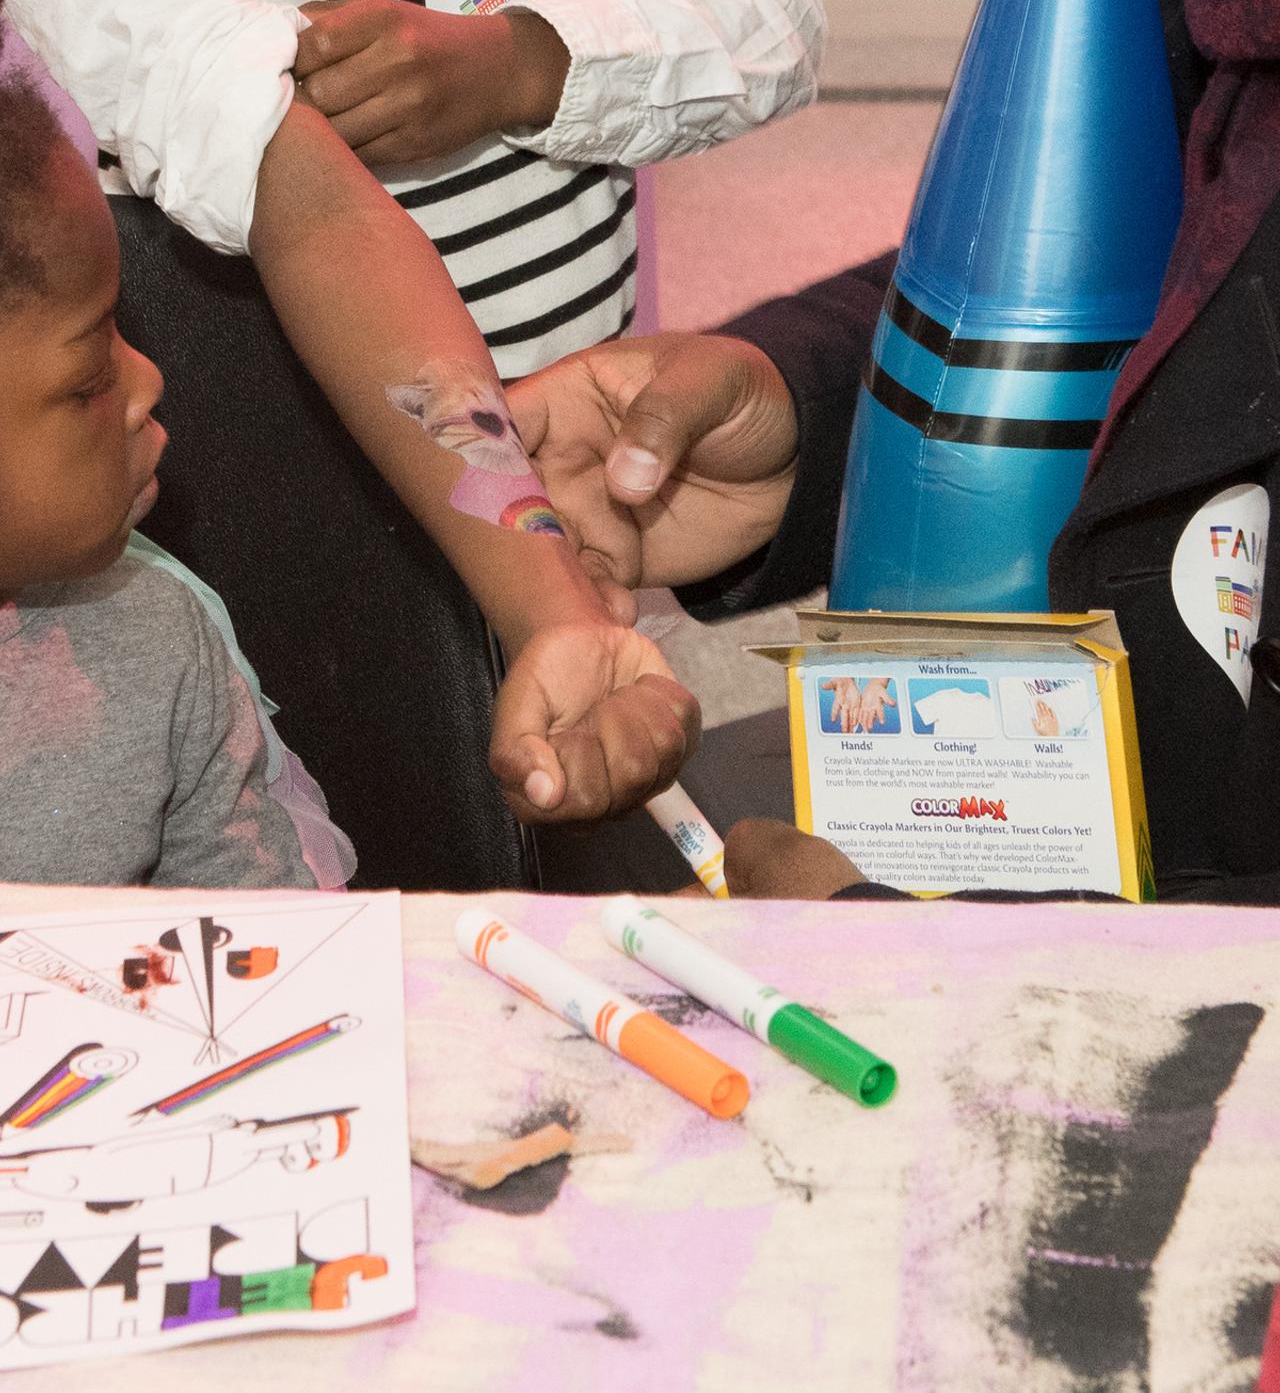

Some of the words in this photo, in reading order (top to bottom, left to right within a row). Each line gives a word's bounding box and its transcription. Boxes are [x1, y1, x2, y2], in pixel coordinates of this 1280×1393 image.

[918, 664, 945, 675] Wash
[946, 664, 977, 675] from...
[841, 740, 873, 751] Hands!
[934, 742, 977, 756] Clothing!
[1034, 743, 1064, 754] Walls!
[824, 756, 852, 768] Crayola
[854, 757, 889, 766] Washable
[891, 758, 922, 766] Markers
[956, 759, 983, 768] ULTRA
[1035, 760, 1073, 769] Washable
[825, 767, 844, 776] from
[863, 768, 895, 778] clothing
[896, 769, 911, 778] and
[912, 770, 935, 778] NOW
[936, 770, 954, 778] from
[956, 770, 986, 780] painted
[1012, 771, 1057, 781] Washability
[826, 778, 844, 787] trust
[846, 778, 864, 787] from
[865, 778, 879, 787] the
[880, 779, 908, 788] world's
[908, 780, 928, 788] most
[930, 780, 964, 789] washable
[827, 821, 857, 831] Classic
[860, 822, 893, 834] Crayola
[895, 823, 932, 832] Markers
[934, 824, 943, 832] in
[945, 824, 962, 833] Our
[1011, 826, 1040, 835] Truest
[1042, 826, 1072, 836] Colors
[1074, 827, 1092, 836] Yet!
[867, 839, 904, 848] dedicated
[906, 840, 915, 848] to
[919, 840, 946, 851] helping
[946, 841, 961, 850] kids
[963, 841, 970, 850] of
[972, 842, 982, 850] all
[984, 844, 1000, 852] ages
[1002, 842, 1032, 851] unleash
[1033, 843, 1046, 851] the
[1048, 845, 1073, 853] power
[1075, 844, 1084, 852] of
[886, 851, 916, 860] colorful
[940, 852, 962, 861] That's
[964, 852, 979, 862] why
[994, 853, 1035, 864] developed
[874, 862, 919, 870] innovations
[930, 863, 974, 874] reinvigorate
[977, 865, 1000, 873] classic
[1003, 866, 1032, 876] Crayola
[1034, 867, 1070, 876] products
[1072, 866, 1090, 876] with
[875, 872, 901, 882] quality
[904, 873, 927, 881] colors
[928, 874, 961, 883] available
